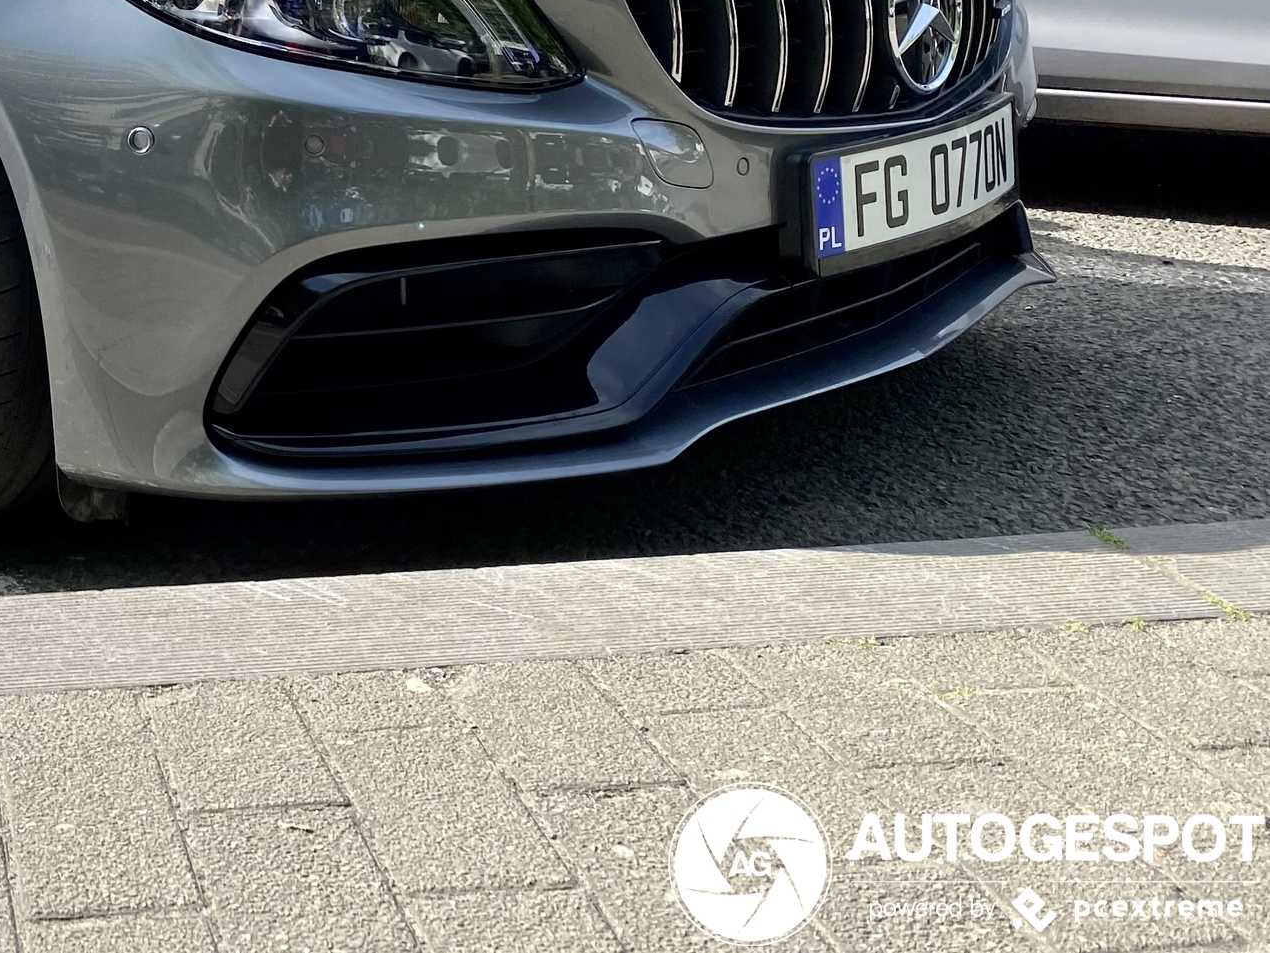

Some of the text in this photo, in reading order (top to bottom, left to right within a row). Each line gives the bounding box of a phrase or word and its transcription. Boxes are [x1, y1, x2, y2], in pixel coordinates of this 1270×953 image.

[854, 117, 1008, 238] FG 0770N
[818, 226, 843, 251] PL
